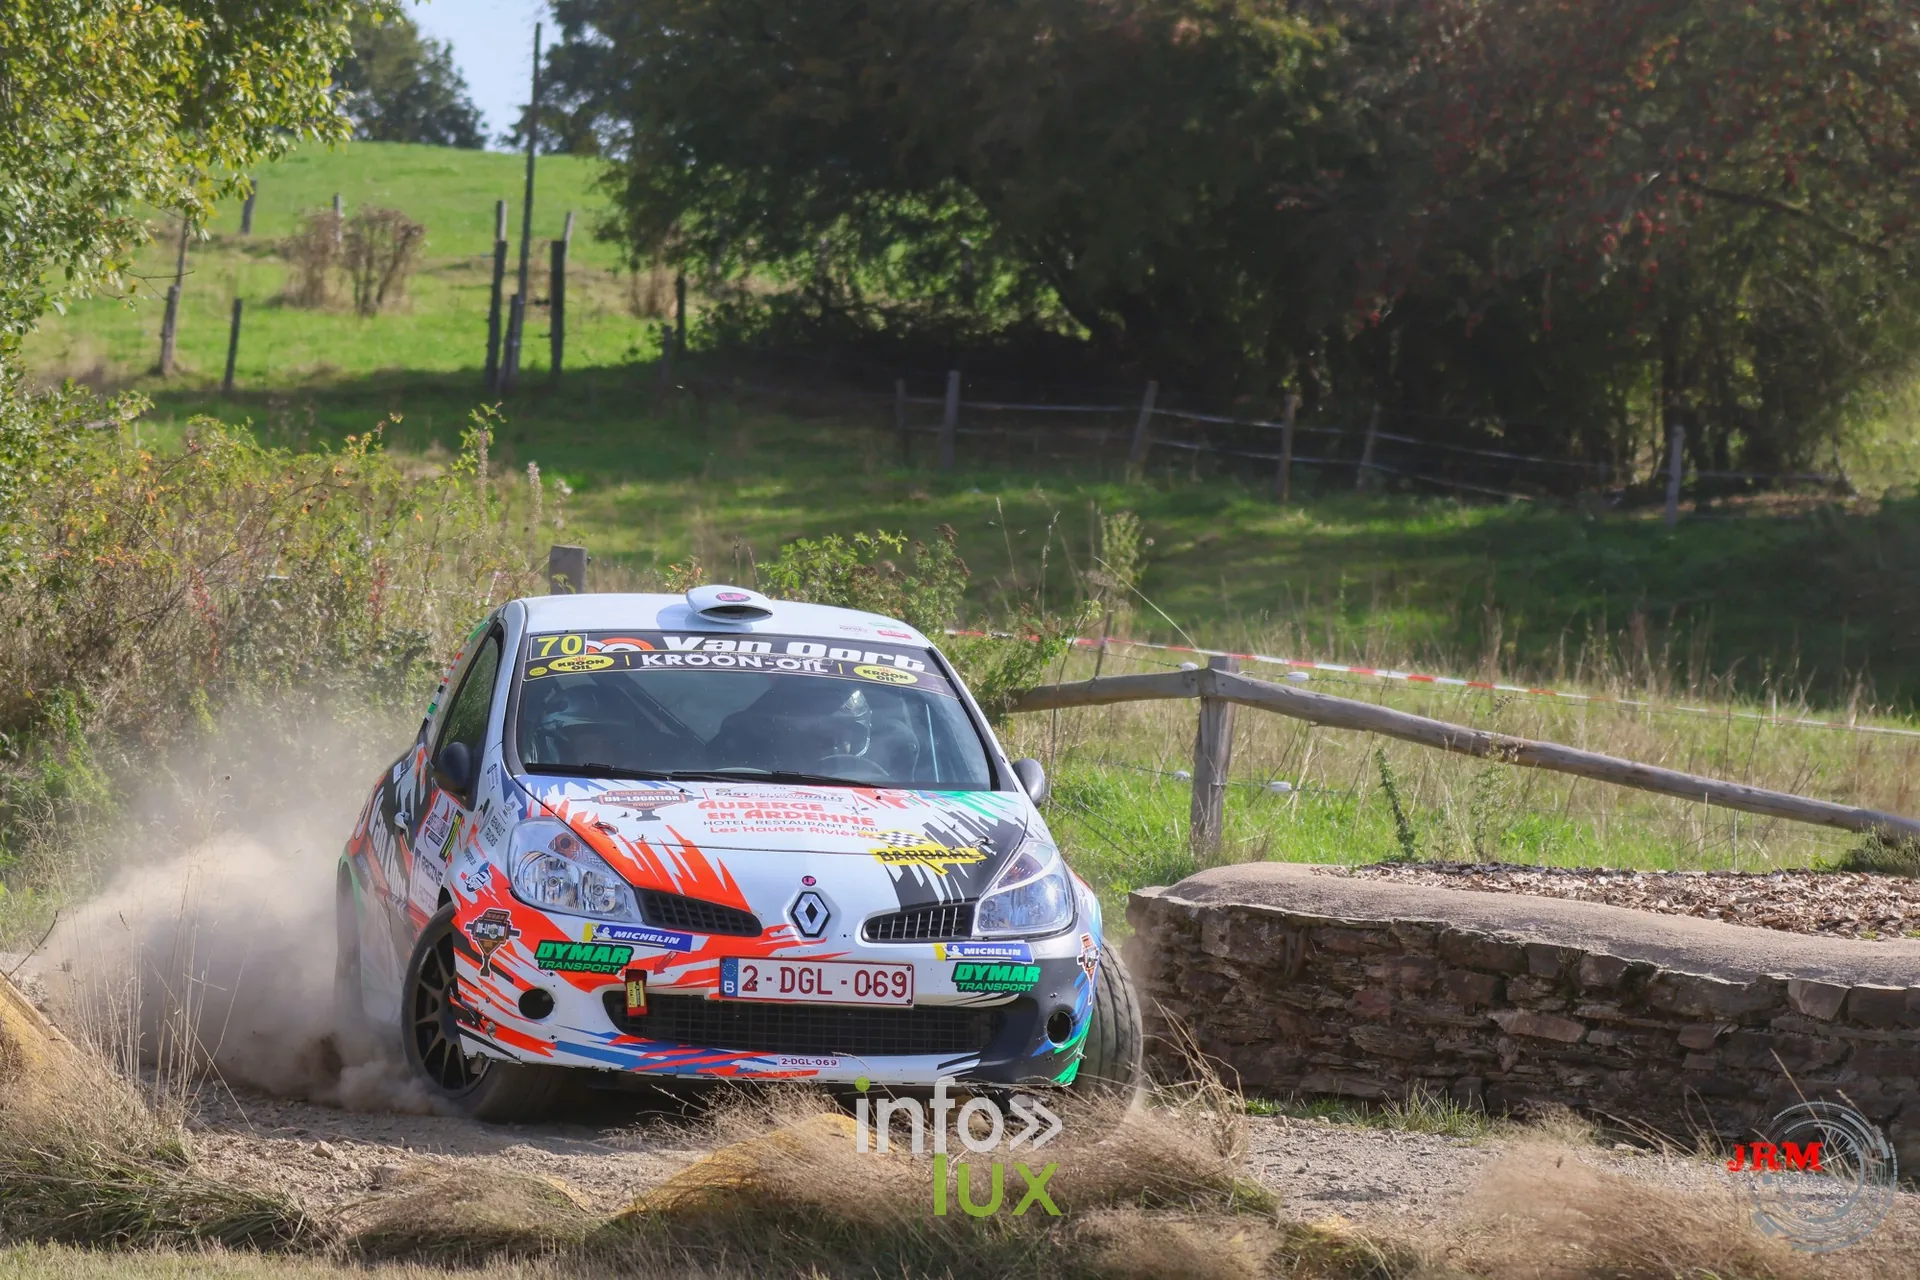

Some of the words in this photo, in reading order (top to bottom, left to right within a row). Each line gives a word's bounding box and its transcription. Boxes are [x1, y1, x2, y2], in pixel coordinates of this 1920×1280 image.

[537, 635, 583, 657] 70
[663, 636, 771, 654] Van
[786, 641, 925, 671] Oort
[557, 659, 605, 668] KROON
[642, 653, 829, 673] KROON-OIL
[862, 669, 908, 680] KROON
[876, 675, 896, 683] OIL
[698, 800, 825, 811] AUBERGE
[744, 808, 876, 826] ARDENNE
[755, 820, 843, 829] RESTAURANT
[613, 930, 681, 944] MICHELIN
[535, 942, 632, 964] DYMAR
[963, 947, 1021, 956] MICHELIN
[539, 960, 621, 973] TRANSPORT
[954, 964, 1041, 982] DYMAR
[723, 980, 735, 993] B
[959, 982, 1034, 992] TRANSPORT
[781, 1057, 837, 1066] 2-DGL-069
